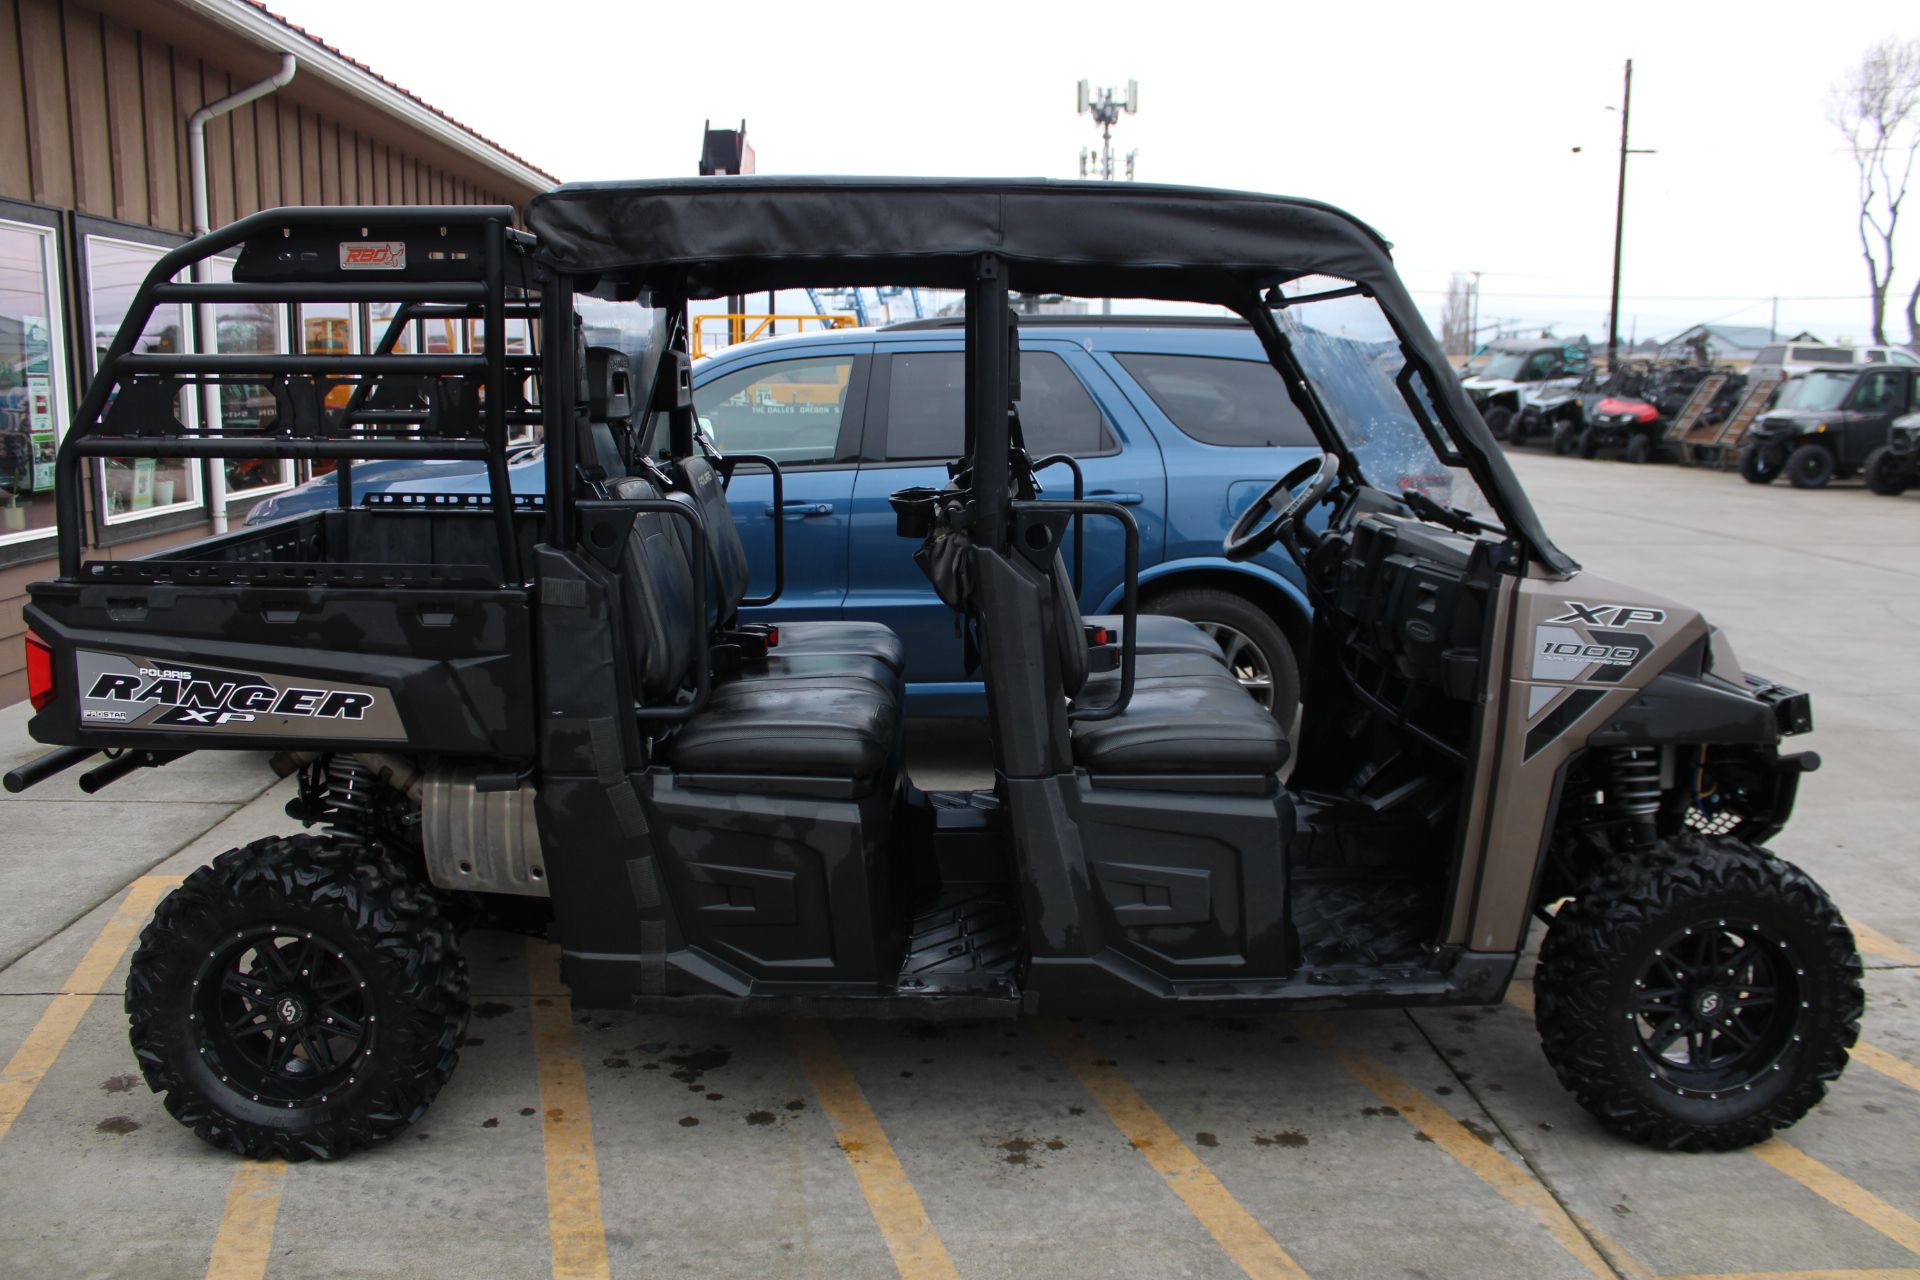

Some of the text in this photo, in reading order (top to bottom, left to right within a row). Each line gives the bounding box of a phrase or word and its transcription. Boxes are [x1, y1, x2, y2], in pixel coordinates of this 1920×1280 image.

[1544, 600, 1667, 628] XP
[1542, 641, 1640, 662] 1000
[139, 667, 192, 680] POLARIS
[85, 672, 374, 721] RANGER
[176, 709, 256, 724] XP
